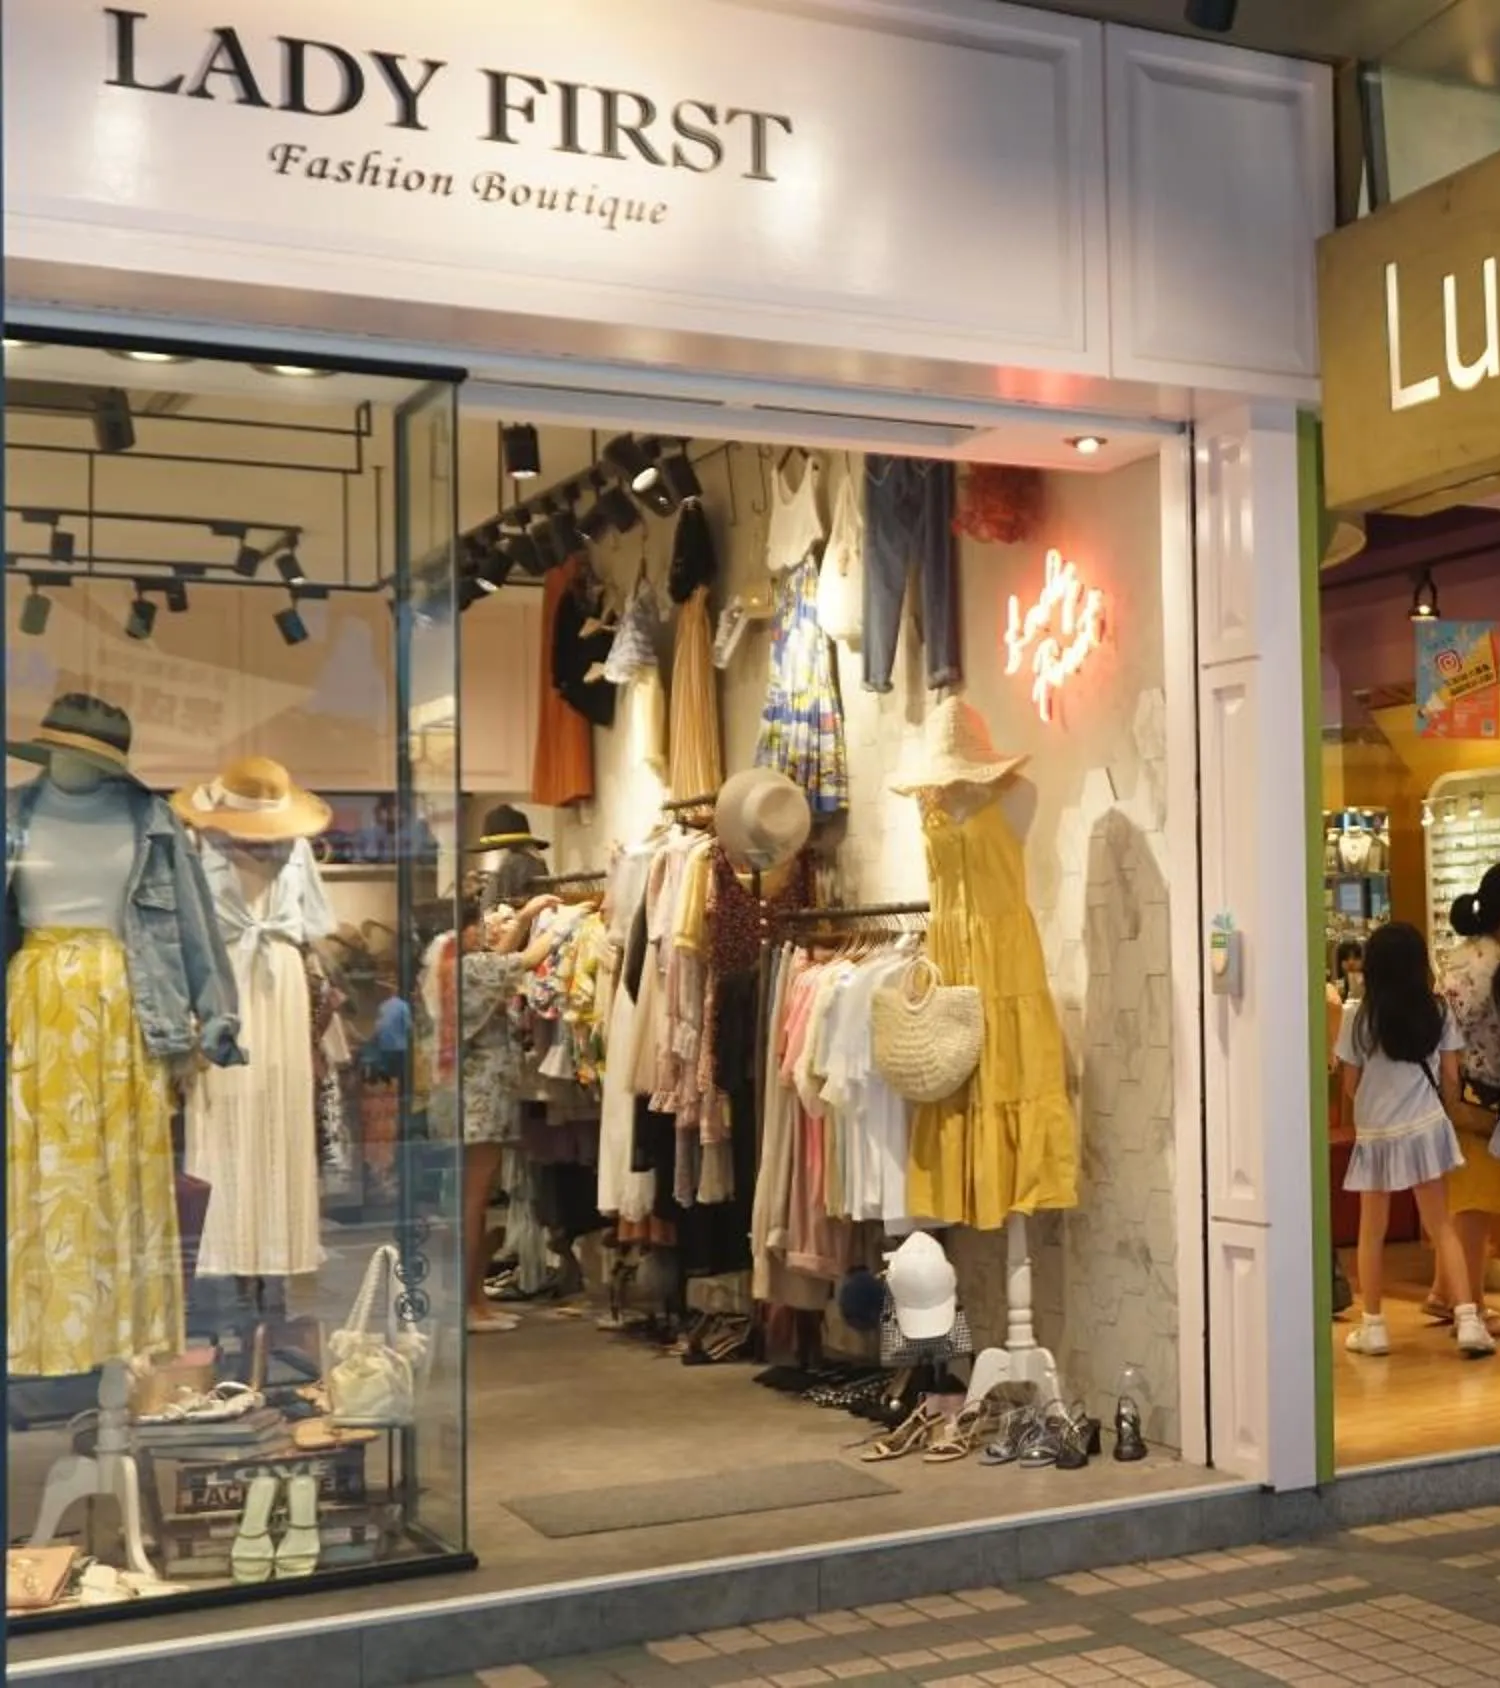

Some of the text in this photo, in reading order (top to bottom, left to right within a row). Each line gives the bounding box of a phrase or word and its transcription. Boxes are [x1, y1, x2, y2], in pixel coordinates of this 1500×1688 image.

[104, 8, 794, 182] LADY FIRST
[267, 142, 668, 231] Fashion Boutique
